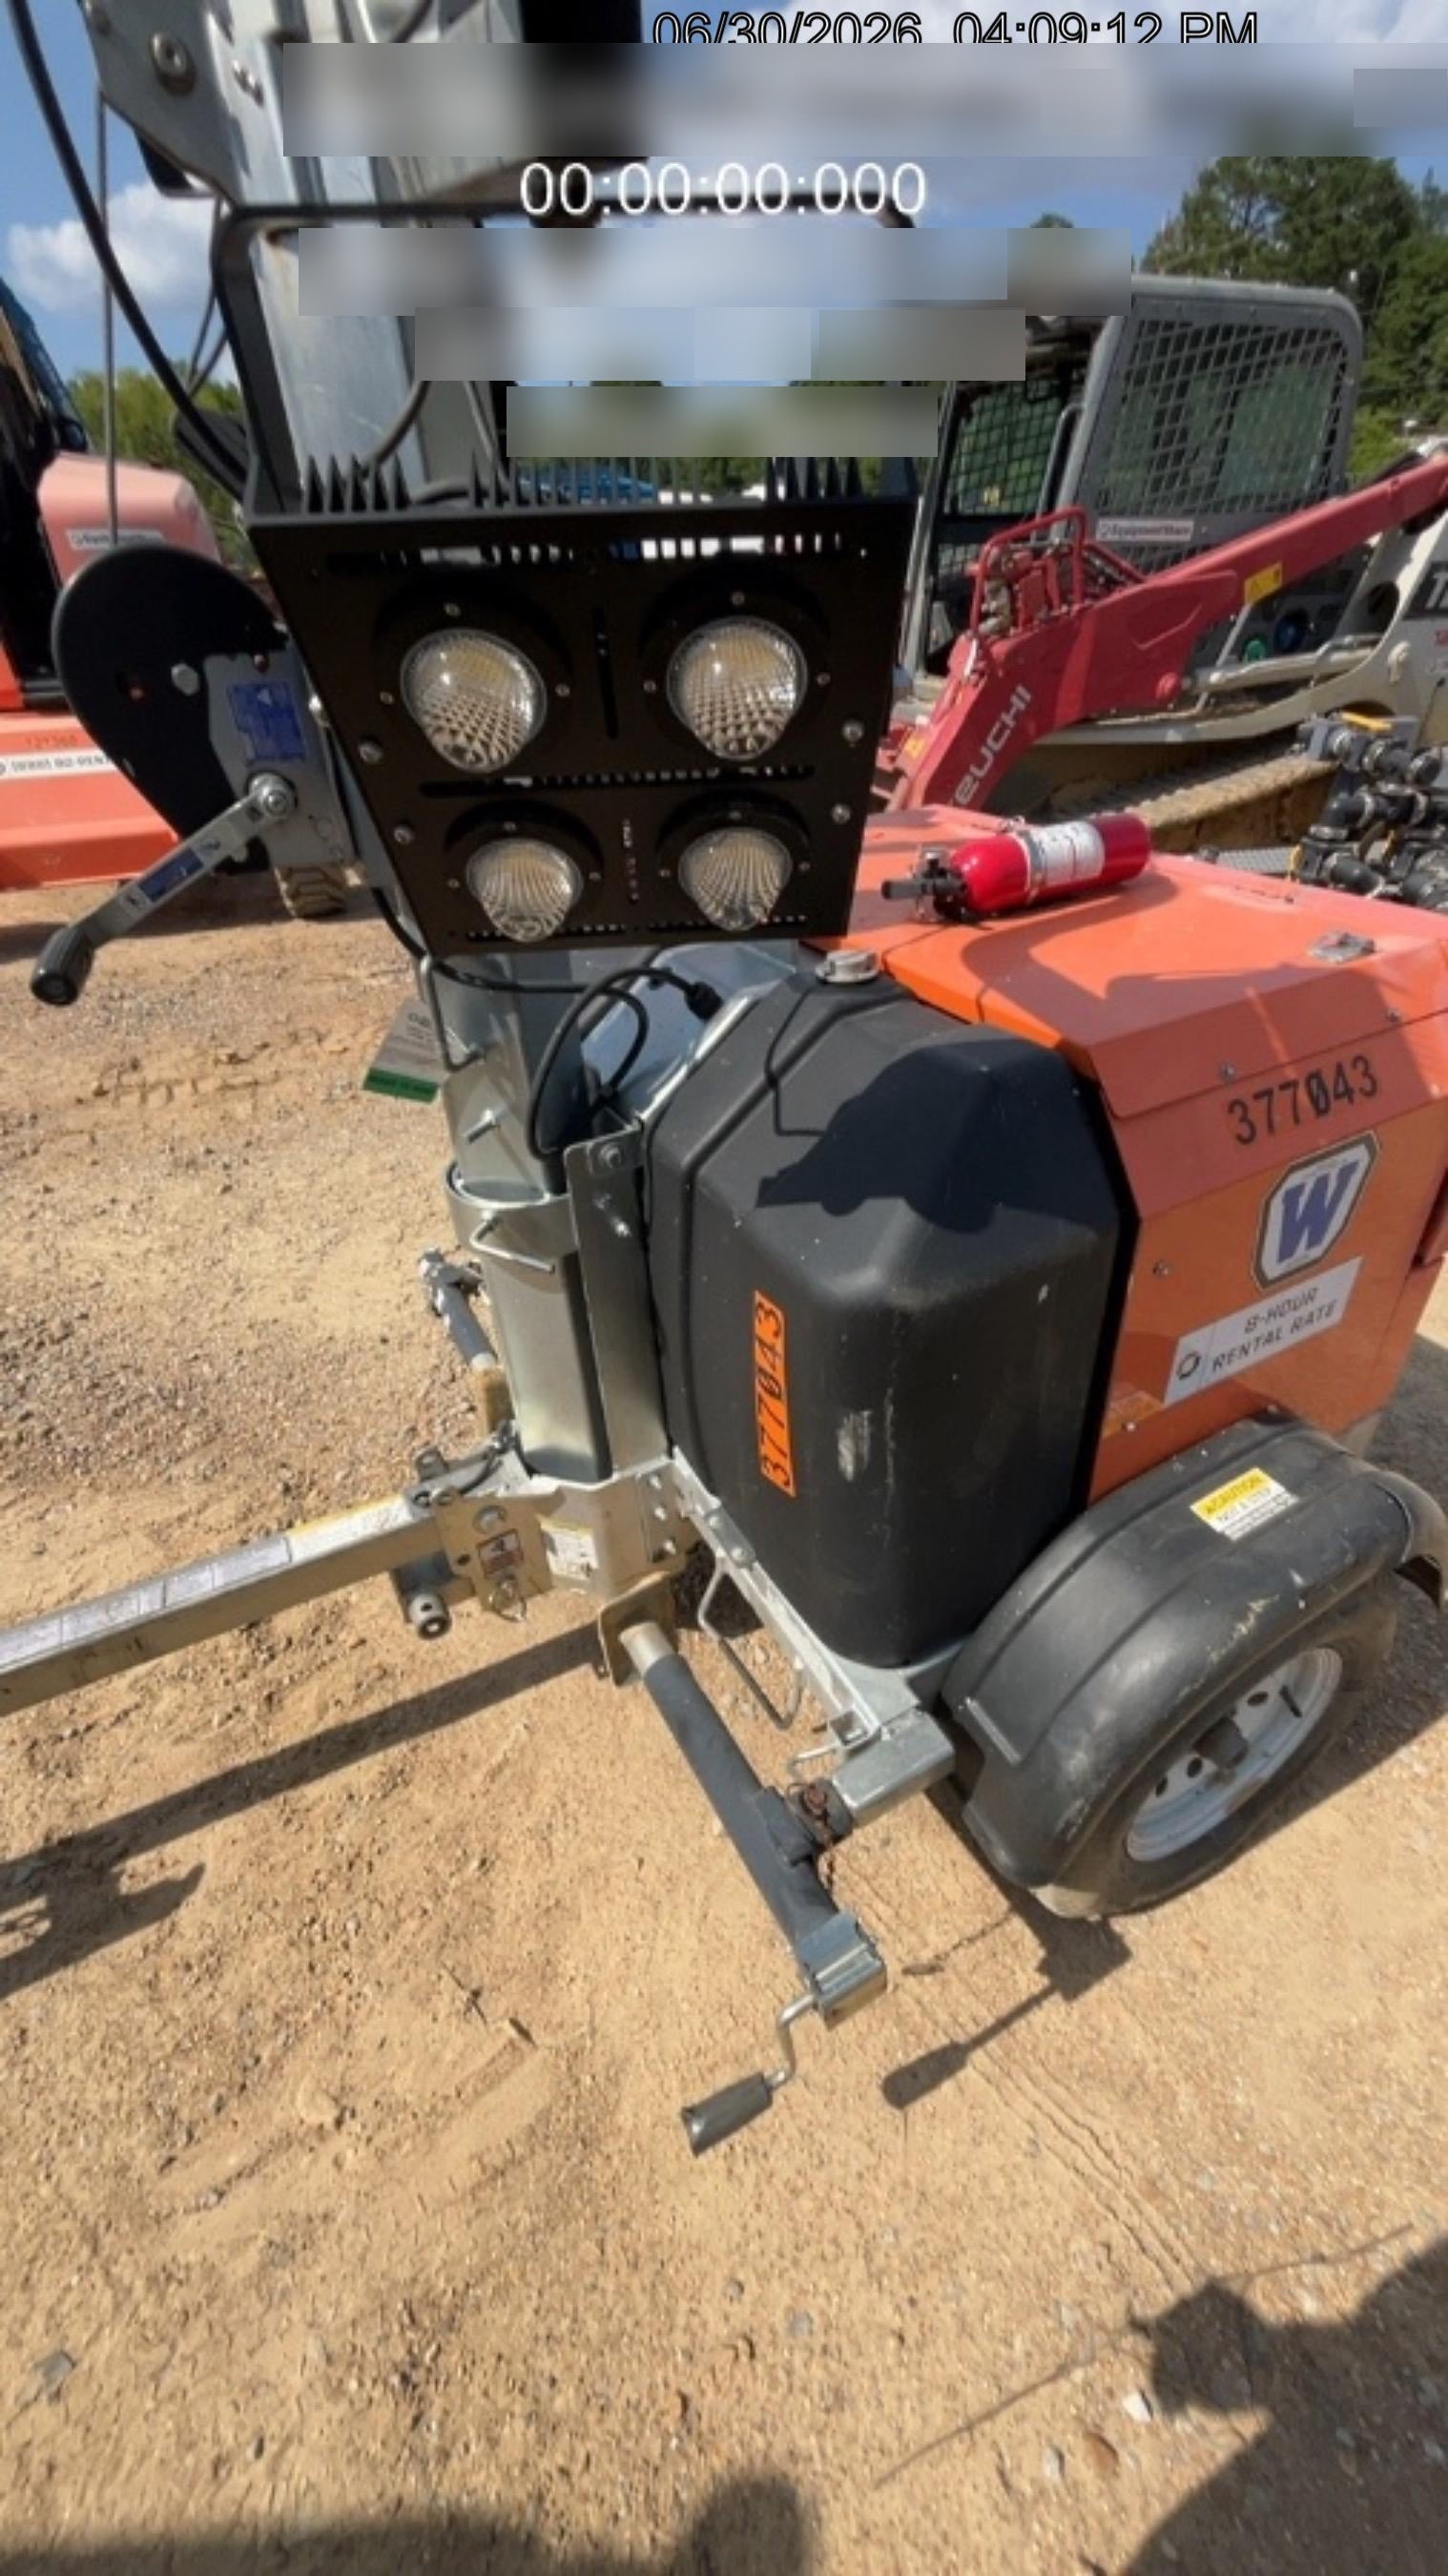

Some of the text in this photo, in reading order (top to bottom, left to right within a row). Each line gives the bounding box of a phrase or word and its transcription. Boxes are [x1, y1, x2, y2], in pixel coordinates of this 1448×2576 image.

[1227, 1055, 1377, 1145] 377043
[1276, 1160, 1361, 1264] W
[1211, 1298, 1339, 1372] RENTAL RATE
[1244, 1287, 1319, 1334] 8-HOUR
[755, 1300, 791, 1487] 377043
